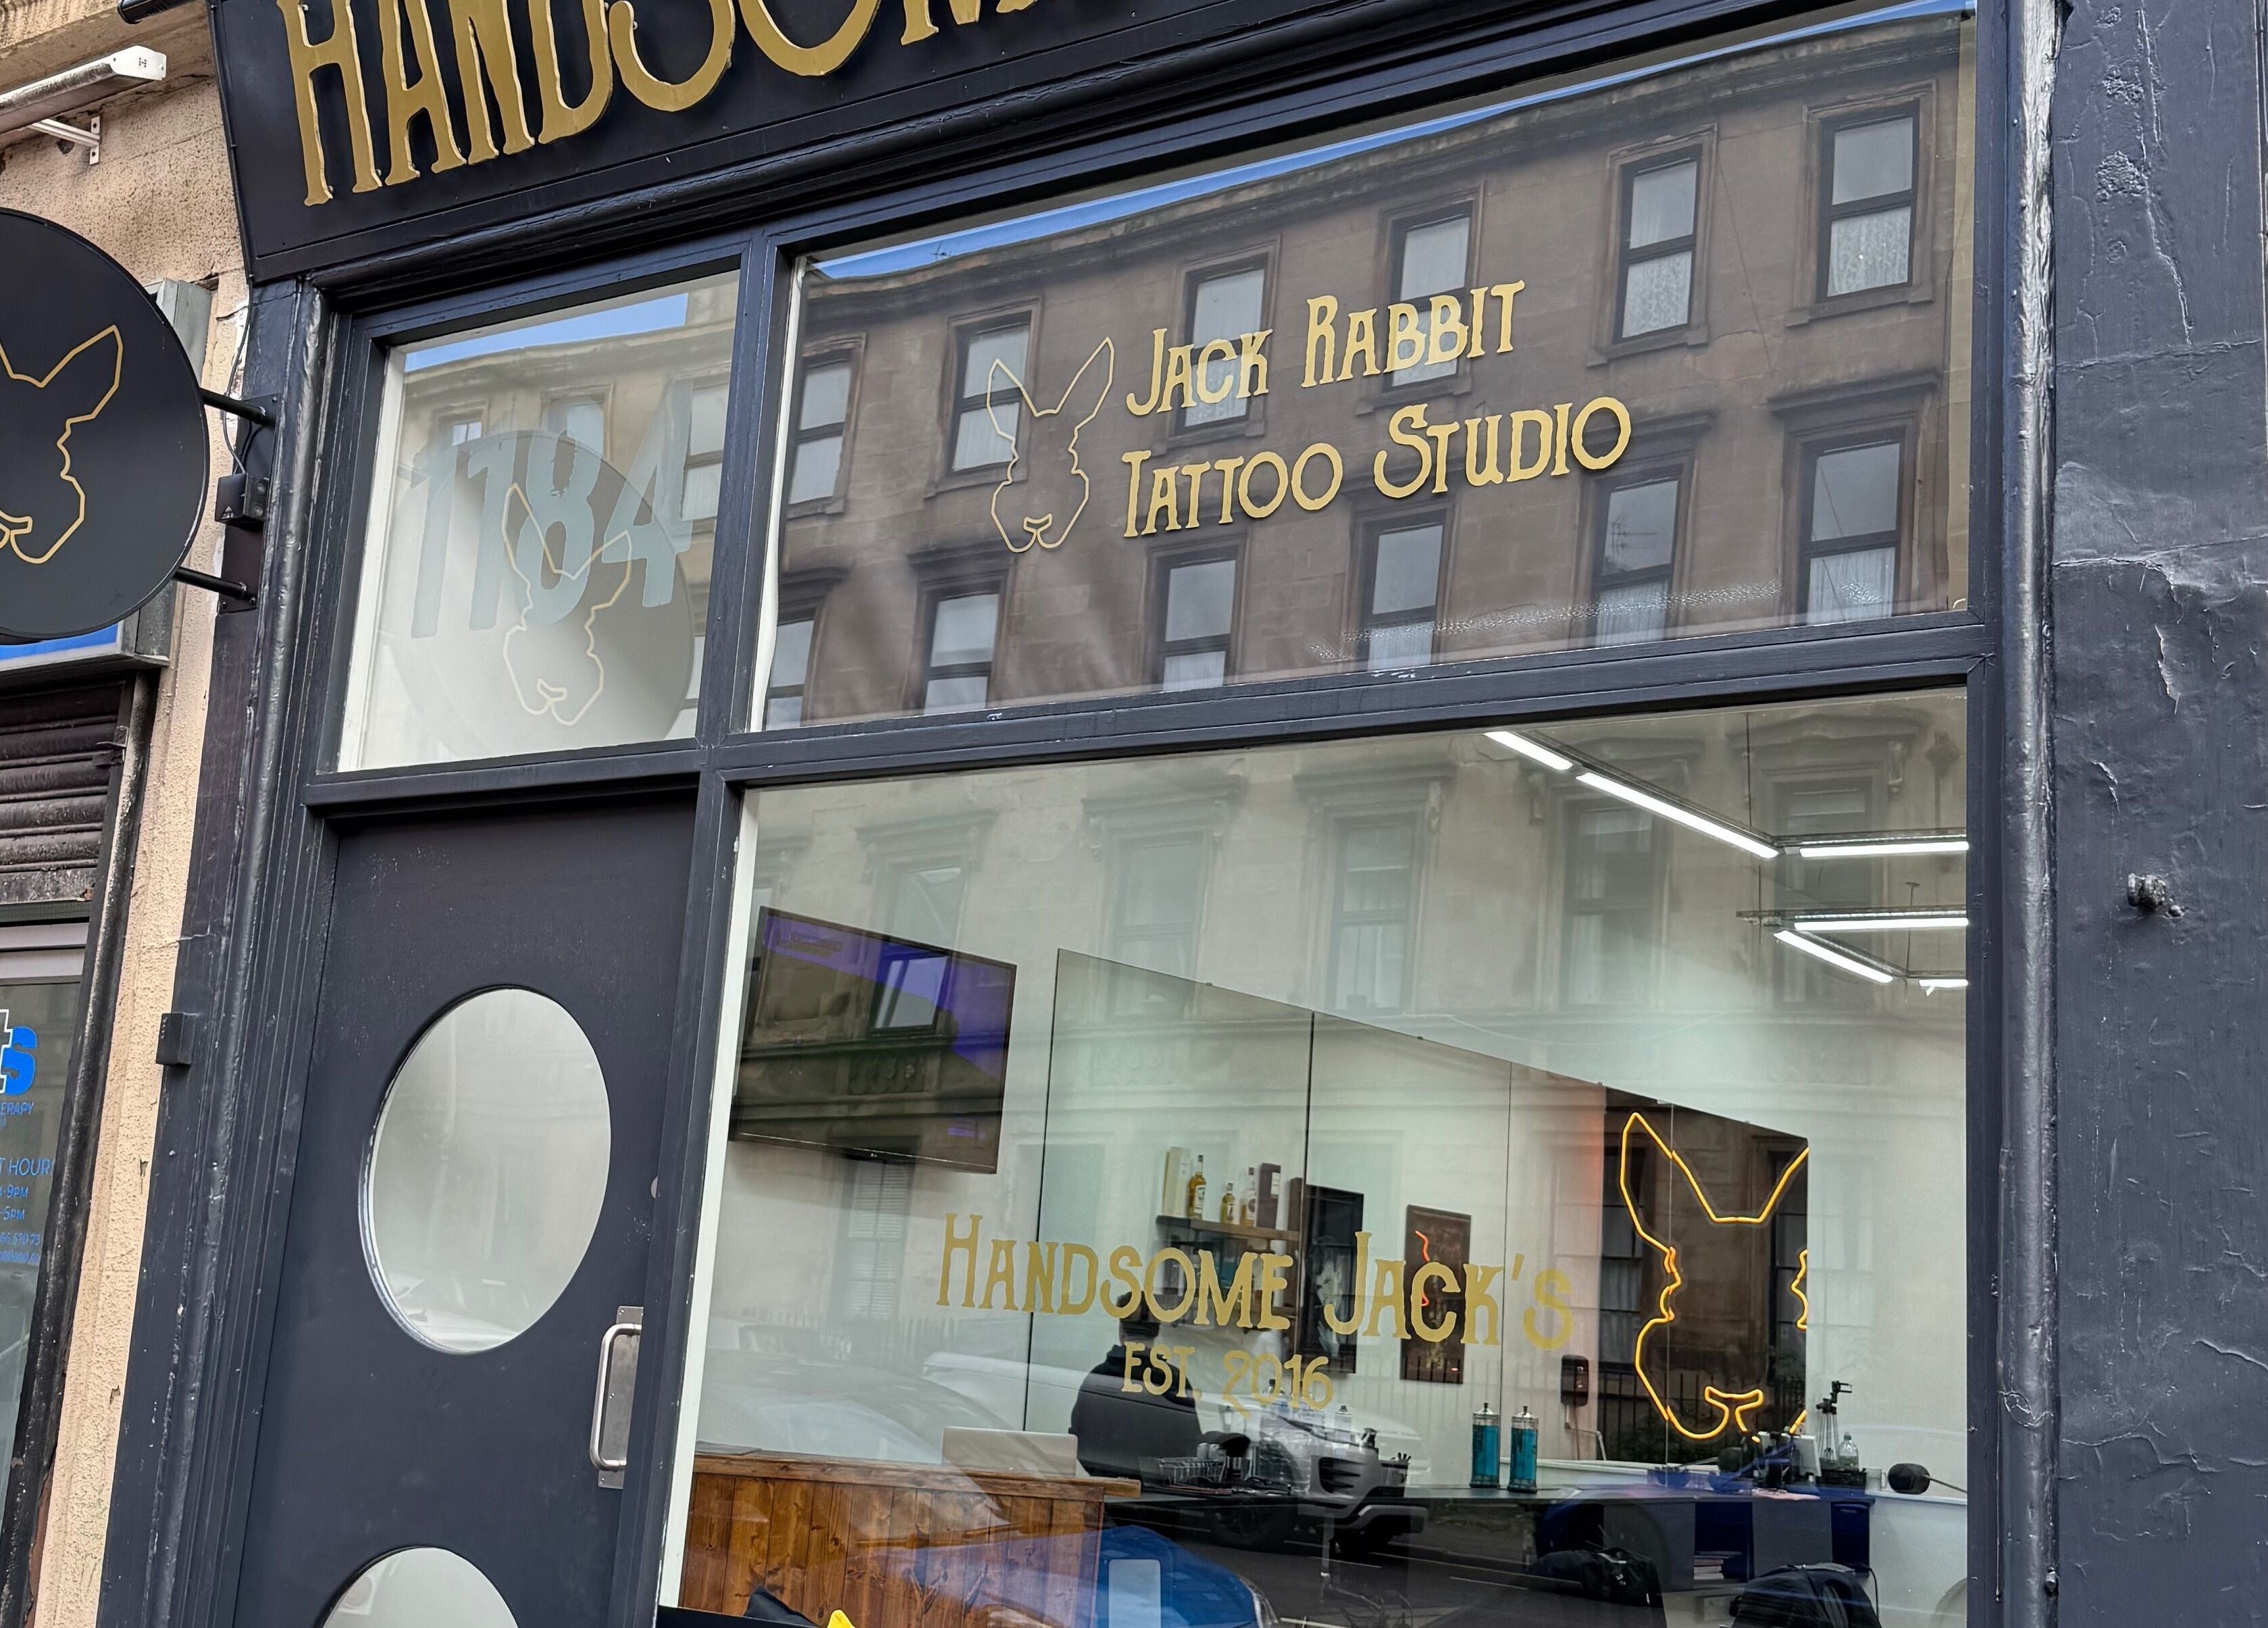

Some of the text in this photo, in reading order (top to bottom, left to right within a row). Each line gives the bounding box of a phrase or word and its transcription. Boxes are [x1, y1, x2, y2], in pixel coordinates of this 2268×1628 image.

[1126, 280, 1526, 416] JACK RABBIT
[409, 375, 693, 640] 1184
[1122, 396, 1632, 538] TATTOO STUDIO
[8, 1157, 54, 1176] HOUR
[936, 1213, 1575, 1350] HANDSOME JACK'S
[1222, 1350, 1334, 1419] 2016
